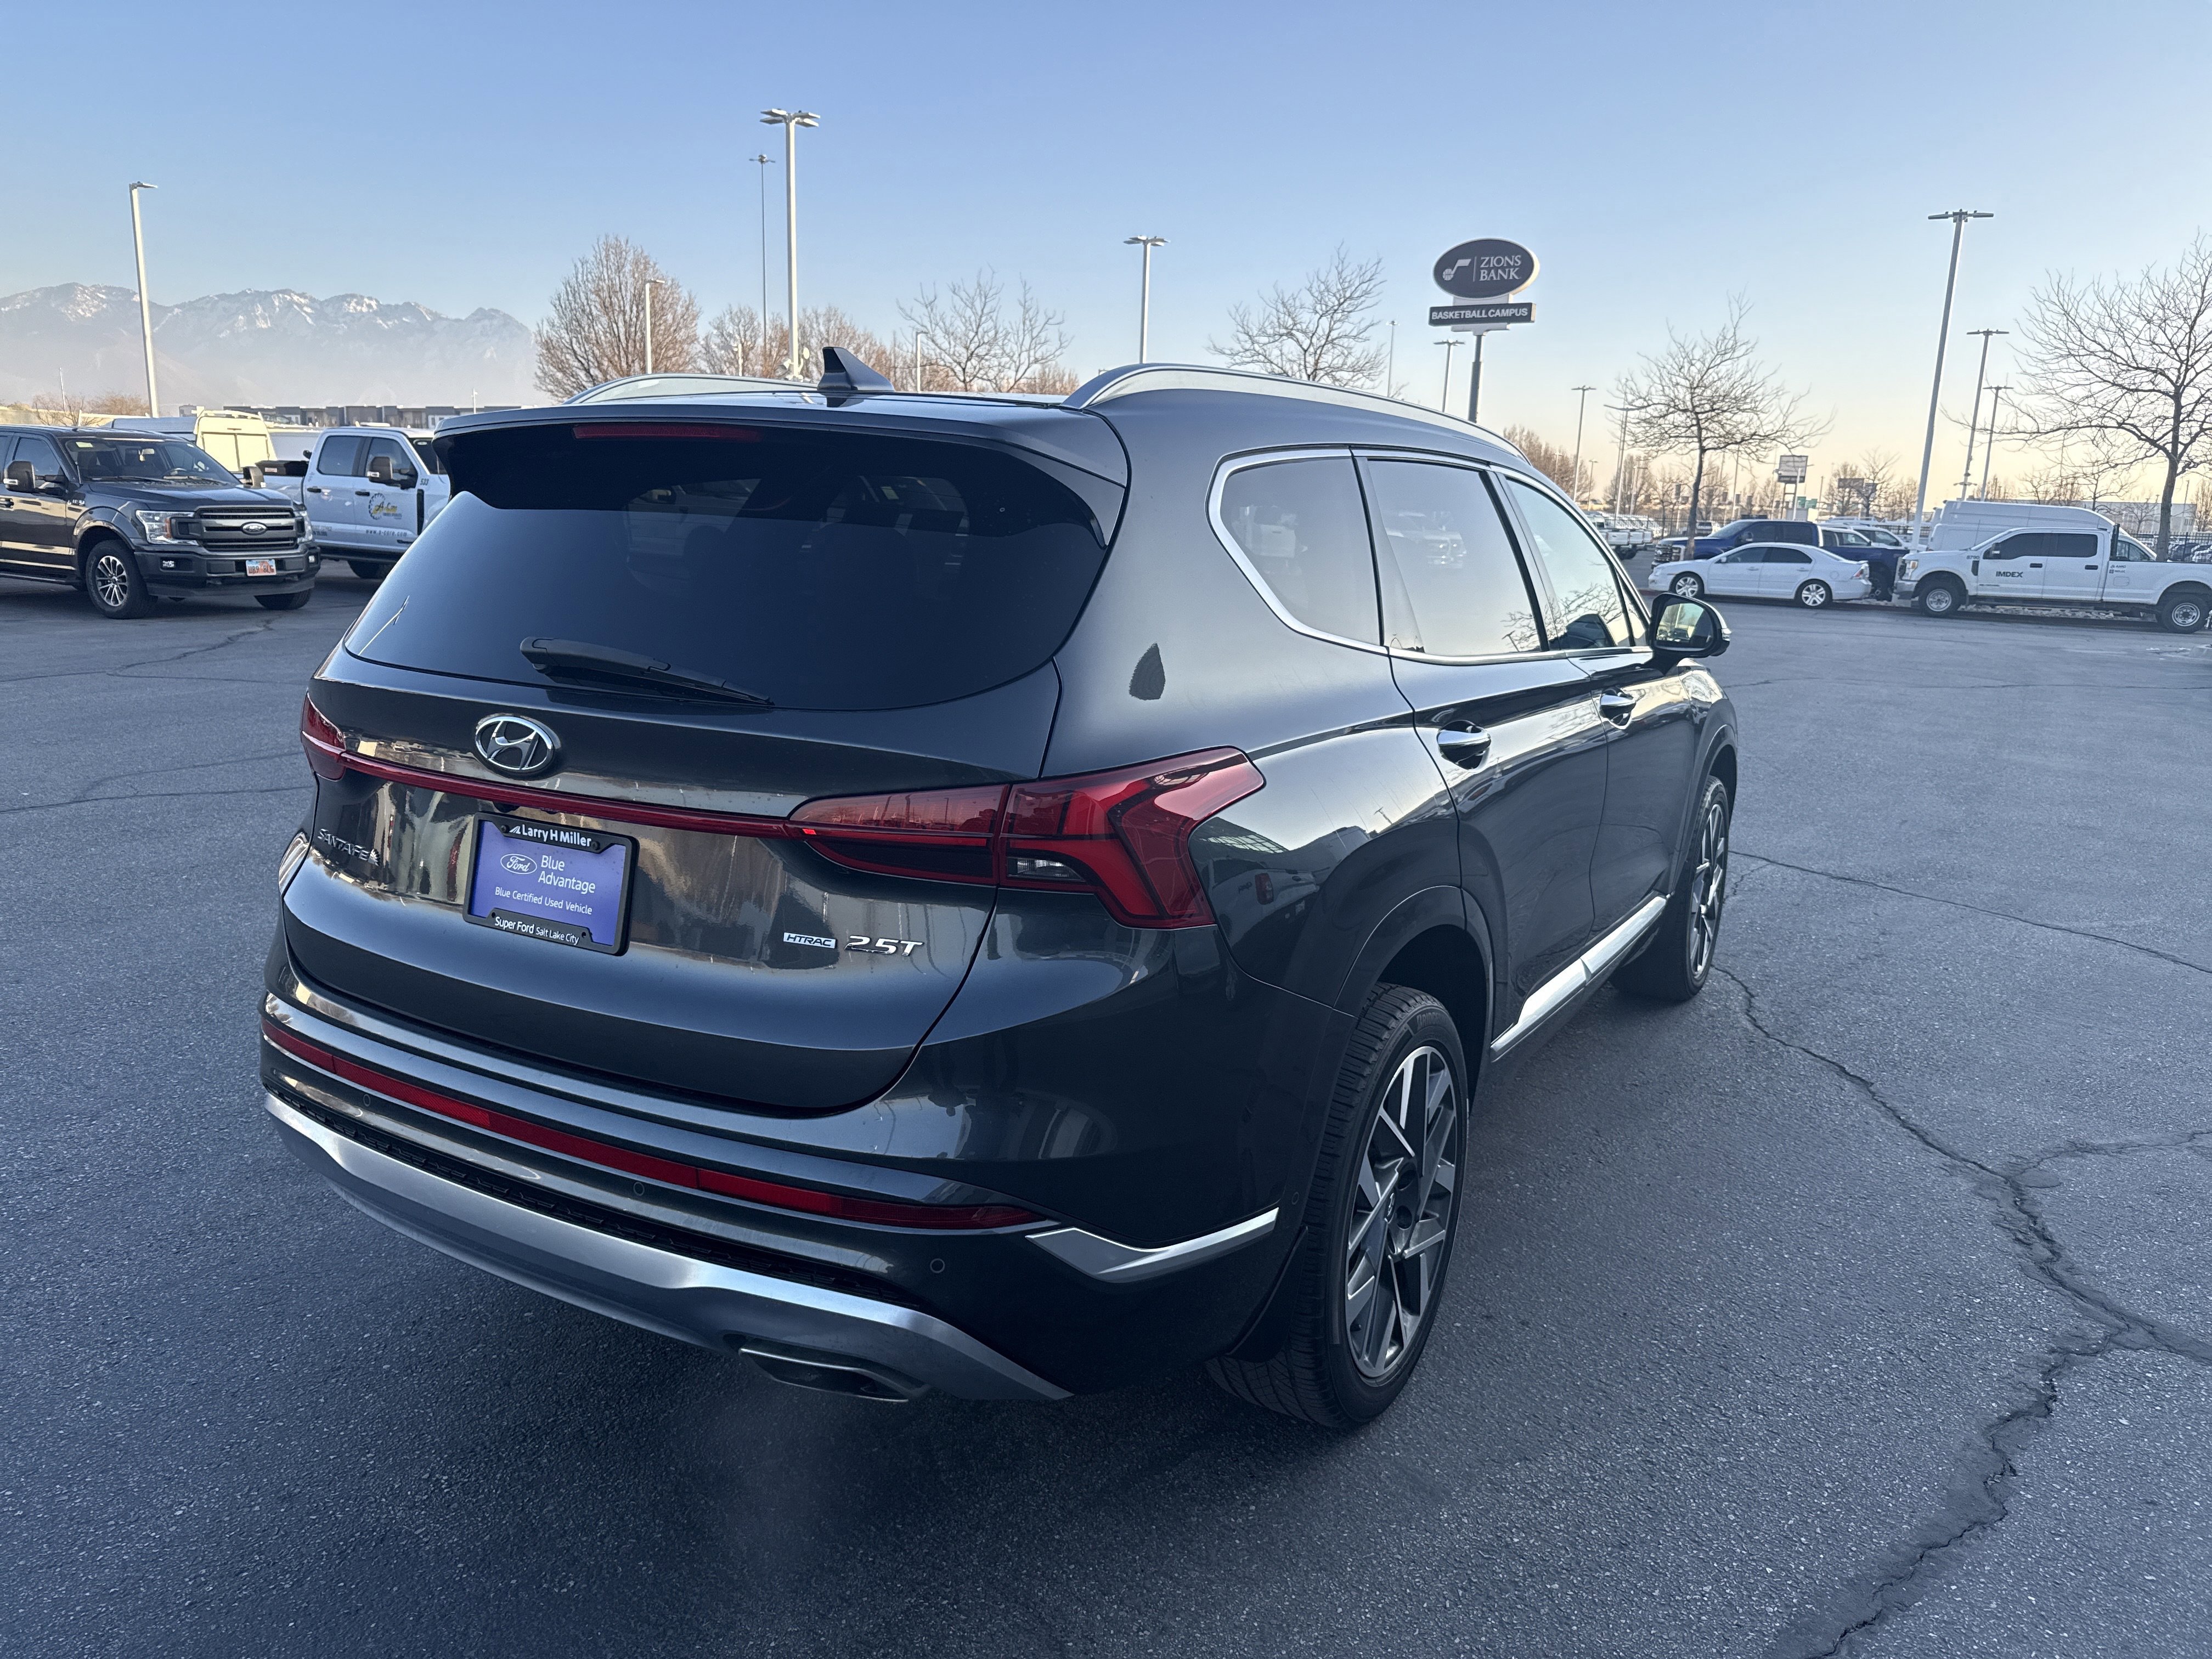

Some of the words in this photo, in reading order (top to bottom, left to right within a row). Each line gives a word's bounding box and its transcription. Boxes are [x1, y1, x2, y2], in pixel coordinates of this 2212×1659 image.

[1481, 255, 1521, 268] ZIONS
[1479, 268, 1521, 281] BANK
[1431, 309, 1486, 320] BASKETBALL
[1486, 308, 1528, 318] CAMPUS
[522, 824, 549, 842] Larry
[550, 829, 558, 841] H
[560, 831, 591, 847] Miller
[506, 856, 531, 872] Ford
[541, 855, 565, 871] Blue
[538, 871, 596, 895] Advantage
[495, 887, 511, 898] Blue
[512, 890, 543, 905] Certified
[545, 896, 563, 909] Used
[566, 900, 592, 915] Vehicle
[494, 916, 516, 930] Super
[516, 921, 535, 934] Ford
[535, 927, 549, 938] Salt
[549, 930, 565, 941] Lake
[566, 933, 579, 945] City
[786, 934, 832, 947] HTRAC
